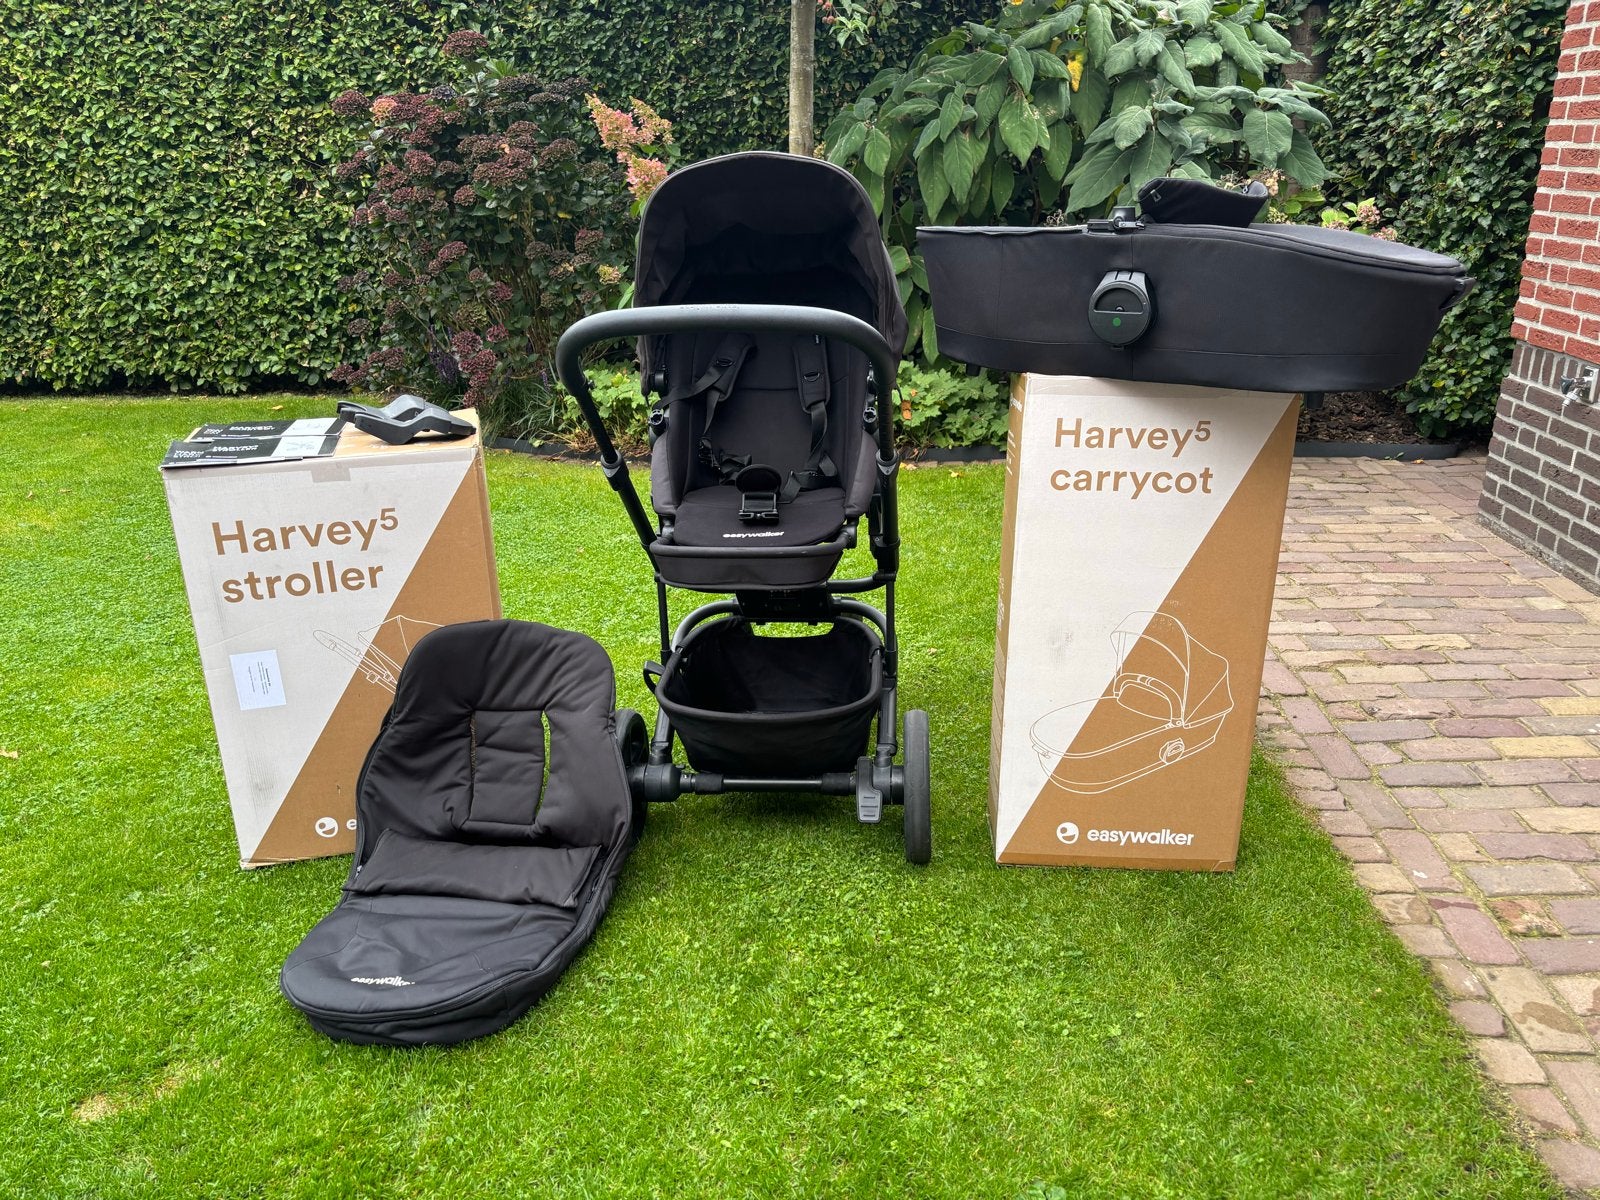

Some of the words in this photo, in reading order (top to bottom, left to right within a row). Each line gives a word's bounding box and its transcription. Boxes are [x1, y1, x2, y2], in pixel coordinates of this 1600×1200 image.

[1050, 467, 1214, 500] carrycot
[222, 560, 384, 603] stroller
[1087, 828, 1195, 846] easywalker
